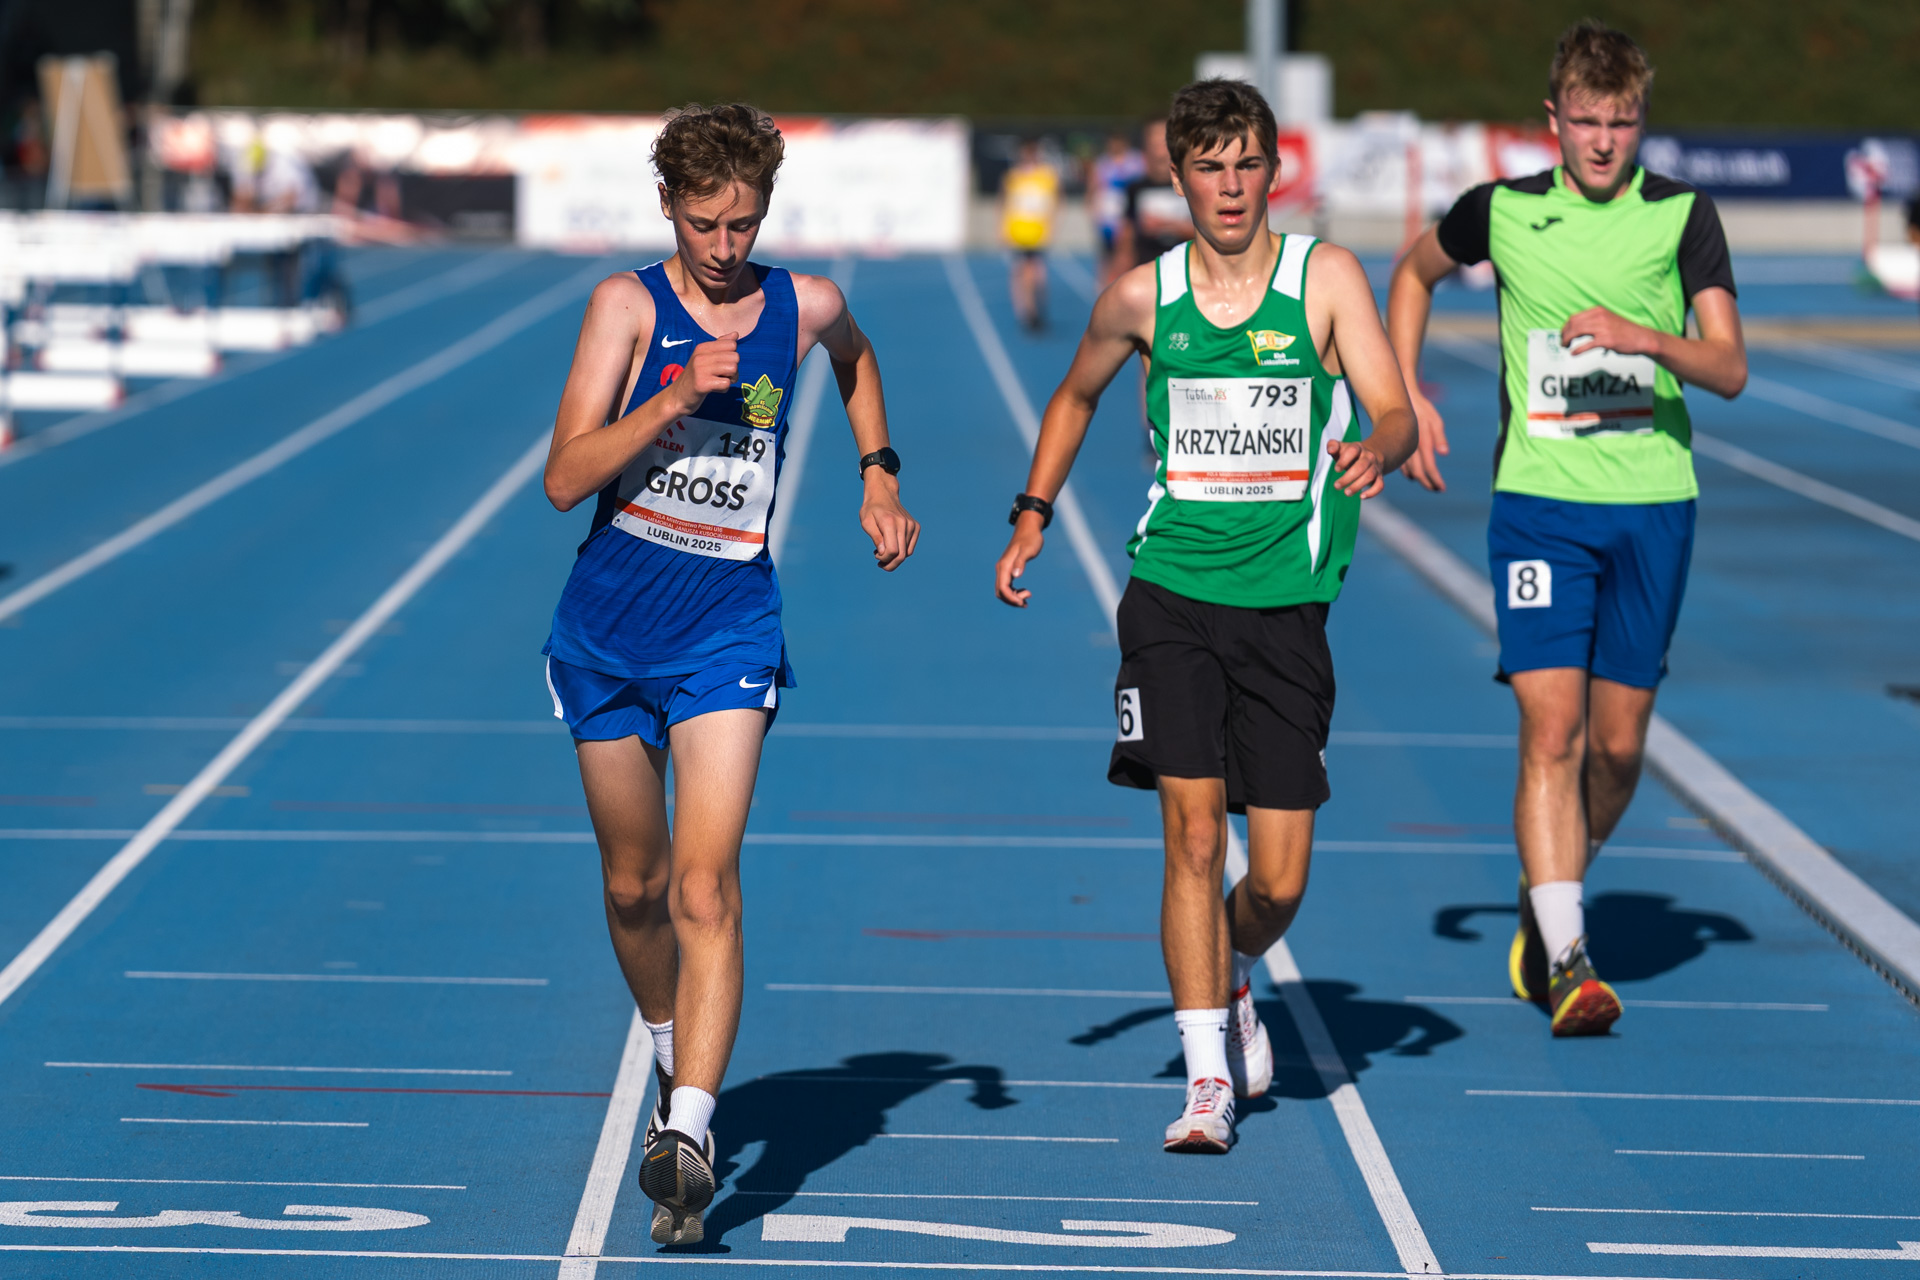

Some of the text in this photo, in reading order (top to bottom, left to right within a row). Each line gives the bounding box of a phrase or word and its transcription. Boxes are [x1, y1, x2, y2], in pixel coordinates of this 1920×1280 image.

[1248, 385, 1298, 408] 793
[1541, 374, 1641, 397] GIEMZA
[652, 438, 684, 454] RLEN
[718, 432, 767, 463] 149
[1175, 423, 1304, 455] KRZYŻAŃSKI
[645, 466, 749, 511] GROSS
[1204, 485, 1274, 495] LUBLIN 2025
[647, 526, 722, 552] LUBLIN 2025
[1517, 566, 1540, 602] 8
[1120, 693, 1134, 736] 6
